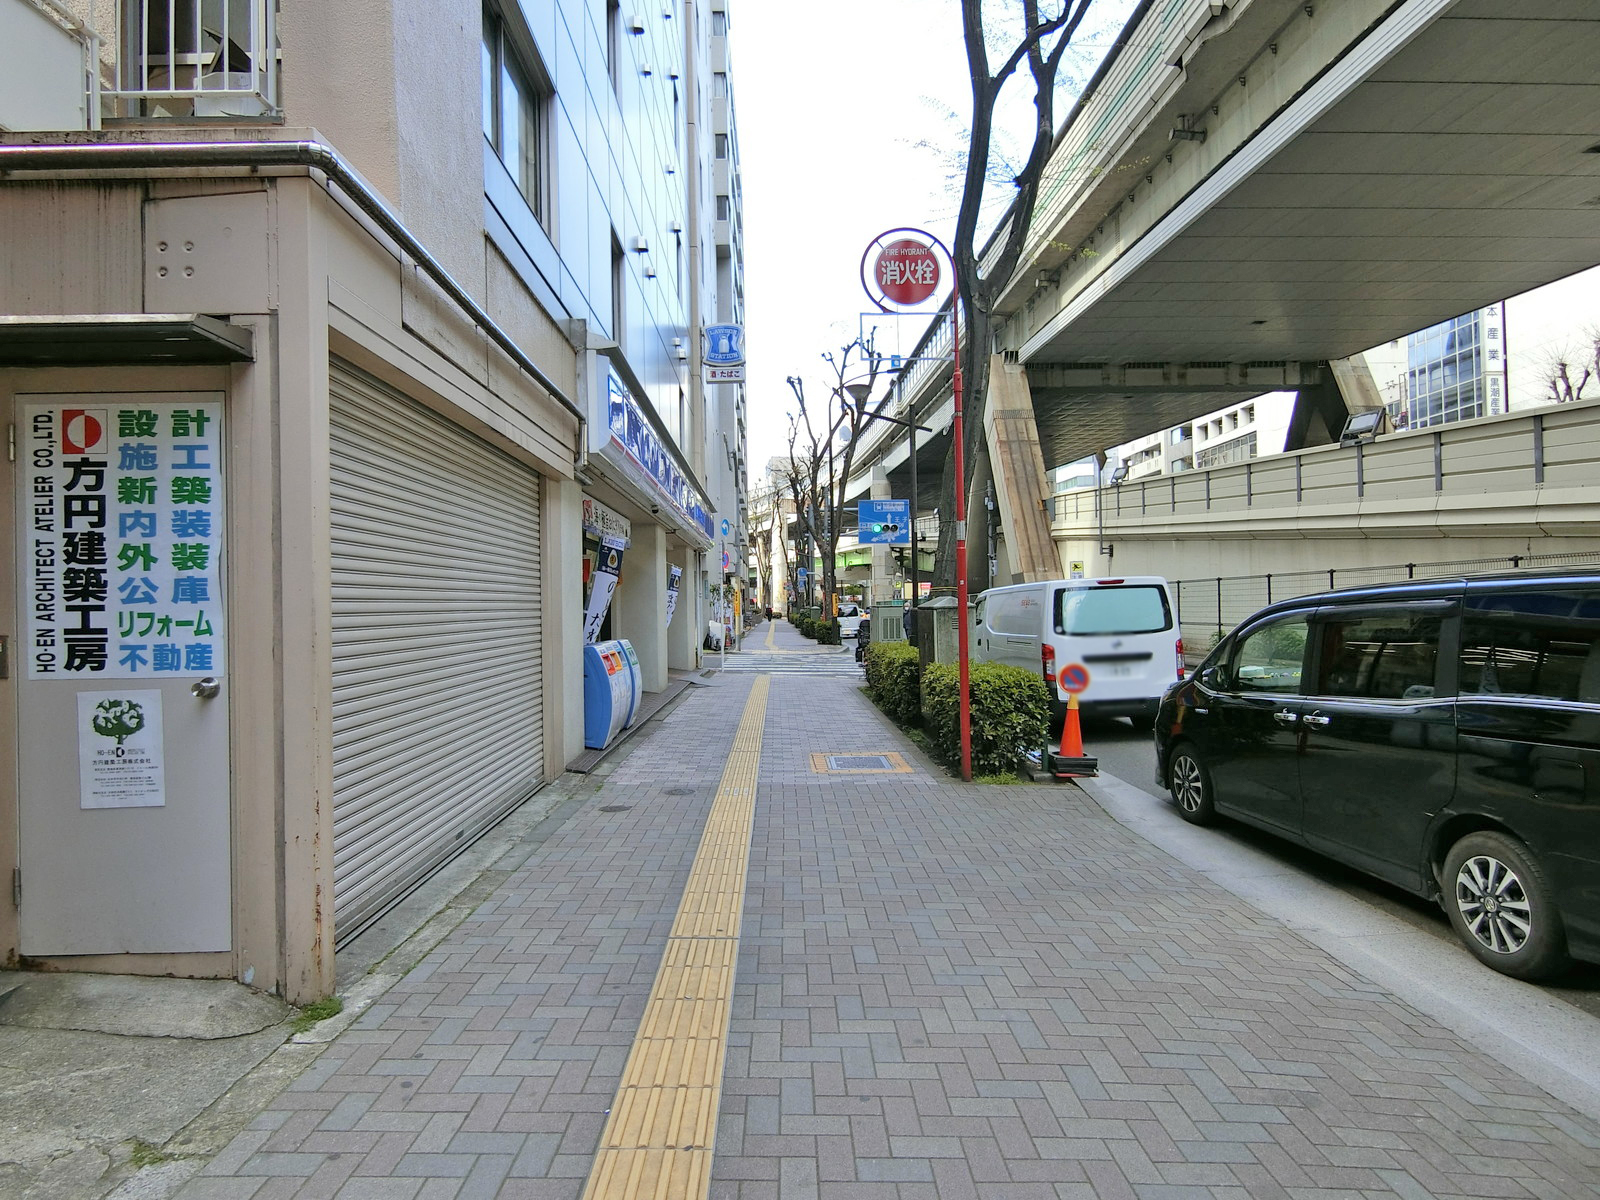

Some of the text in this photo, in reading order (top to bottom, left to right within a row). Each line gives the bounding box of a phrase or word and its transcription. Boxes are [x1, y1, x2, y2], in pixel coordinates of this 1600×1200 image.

[885, 247, 929, 256] FIRE HYDRANT
[881, 259, 935, 285] 消火栓
[709, 328, 738, 337] LAWSON
[709, 352, 738, 360] STATION
[33, 475, 55, 532] ATELIER
[62, 457, 109, 672] 方円建築工房
[35, 539, 55, 622] ARCHITECT
[118, 610, 214, 638] リフォーム
[119, 643, 213, 672] 不動産
